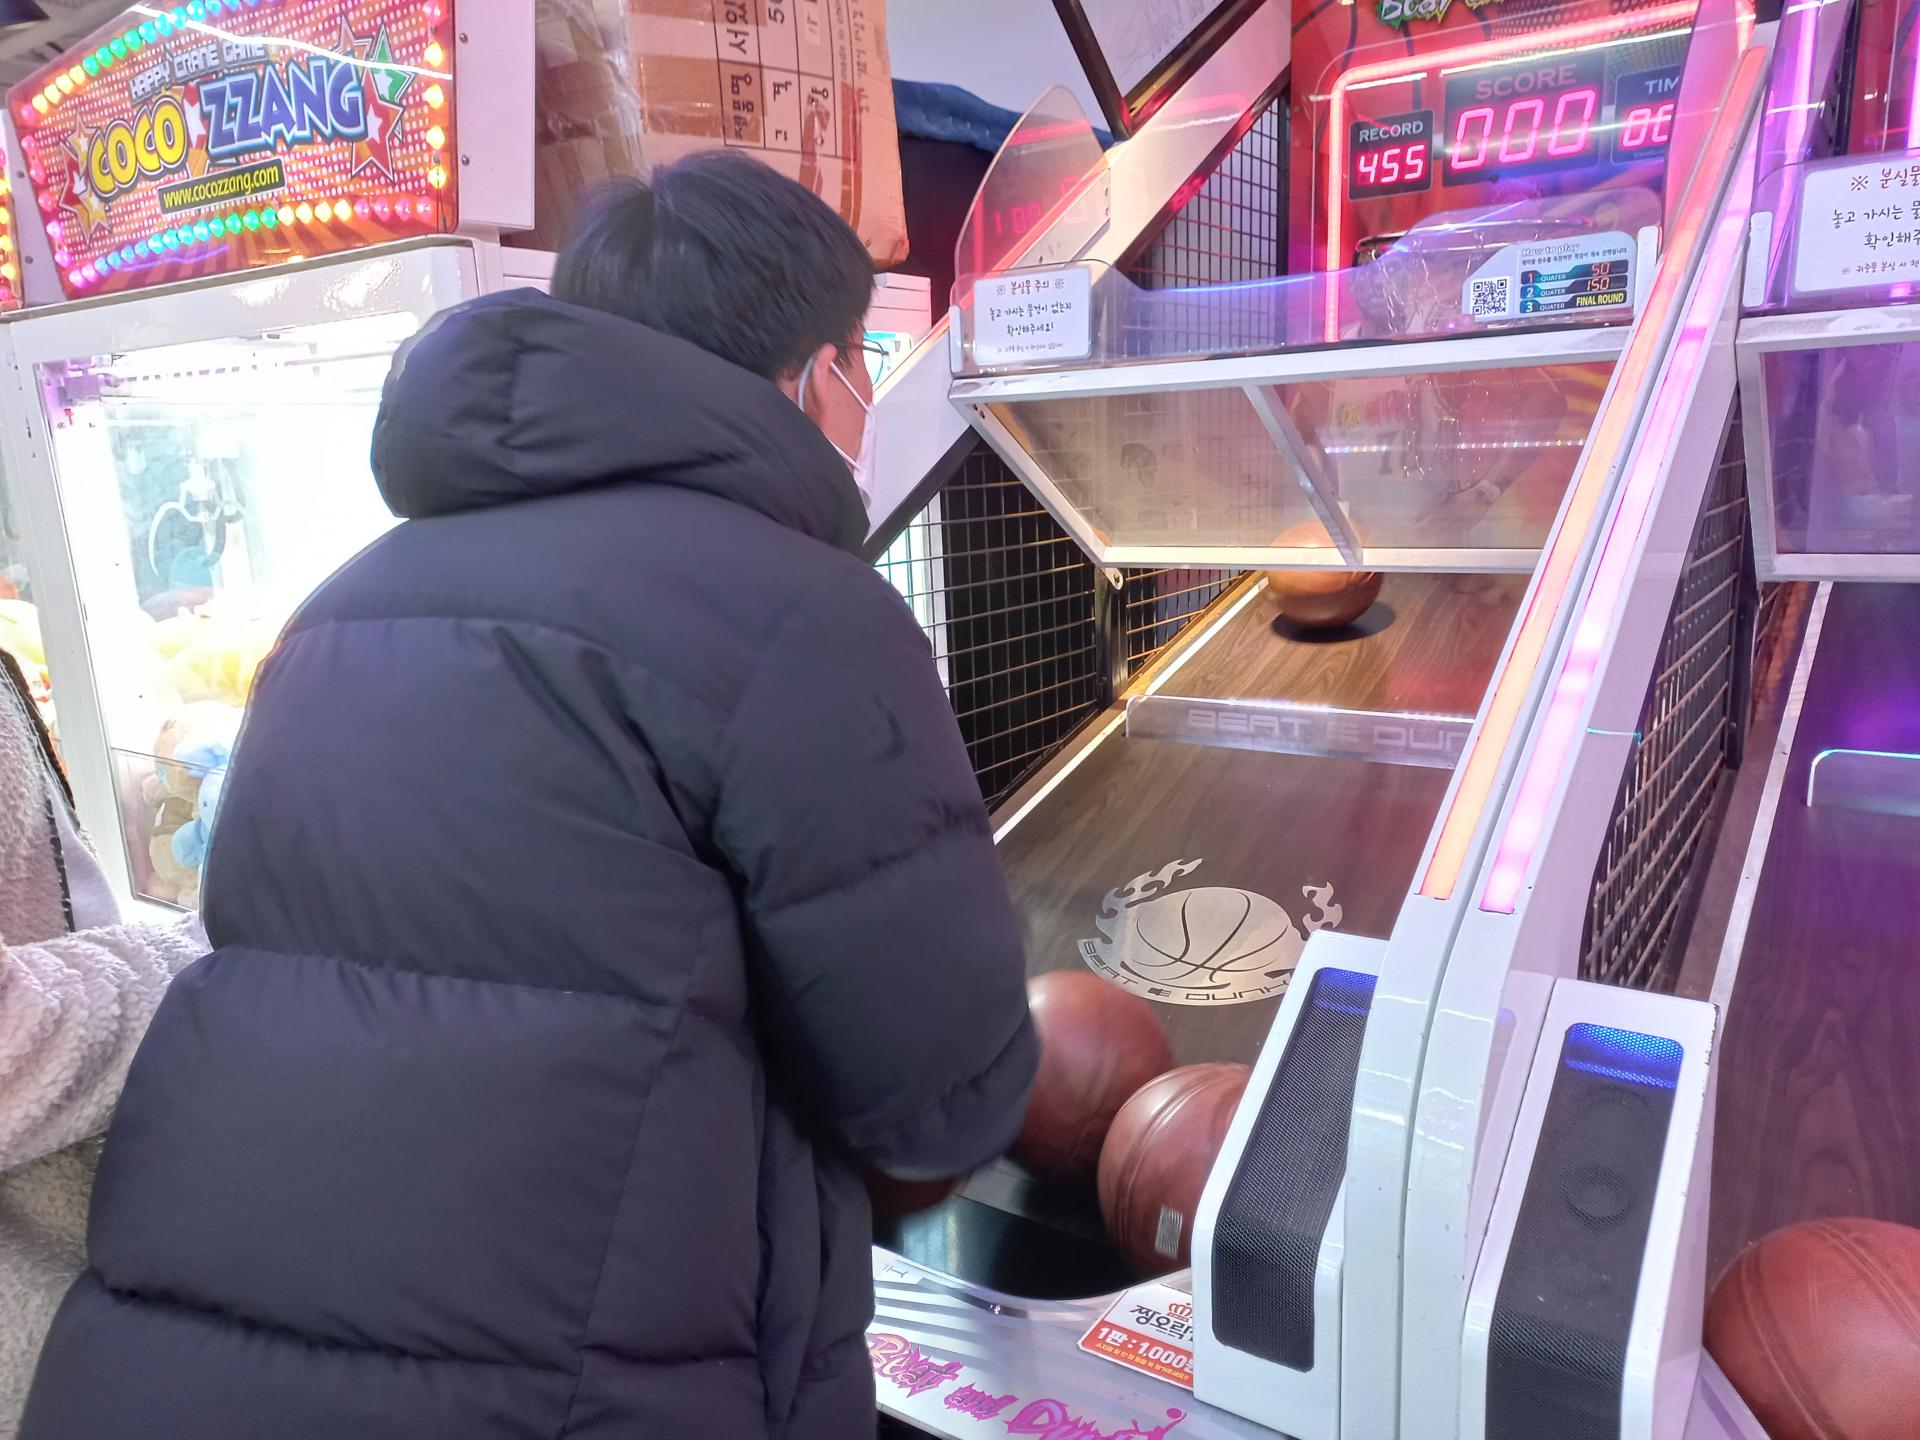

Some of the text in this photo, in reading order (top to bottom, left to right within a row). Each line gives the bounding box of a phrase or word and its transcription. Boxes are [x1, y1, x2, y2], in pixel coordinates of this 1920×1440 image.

[1475, 65, 1577, 99] SCORE
[1644, 76, 1680, 95] TIM
[90, 58, 367, 195] COCO ZZANG
[1358, 120, 1424, 143] RECORD
[1449, 89, 1598, 170] 000
[1358, 145, 1425, 183] 455
[163, 164, 280, 208] www.cocozzang.com
[1832, 209, 1856, 229] 놓고
[1863, 204, 1904, 220] 가시는
[1591, 263, 1610, 276] 50
[1011, 280, 1049, 295] 분실물 주의
[1527, 278, 1610, 298] 2 QUATER 150
[990, 307, 1002, 321] 놓고
[1005, 306, 1024, 317] 가시는
[1027, 304, 1048, 317] 물건이
[1526, 292, 1624, 312] 3 QUATER FINAL ROUND
[1007, 322, 1054, 336] 확인해주세요!
[1188, 709, 1312, 738] BEAT
[1373, 726, 1470, 750] DUN
[1129, 1304, 1193, 1342] 짱오락
